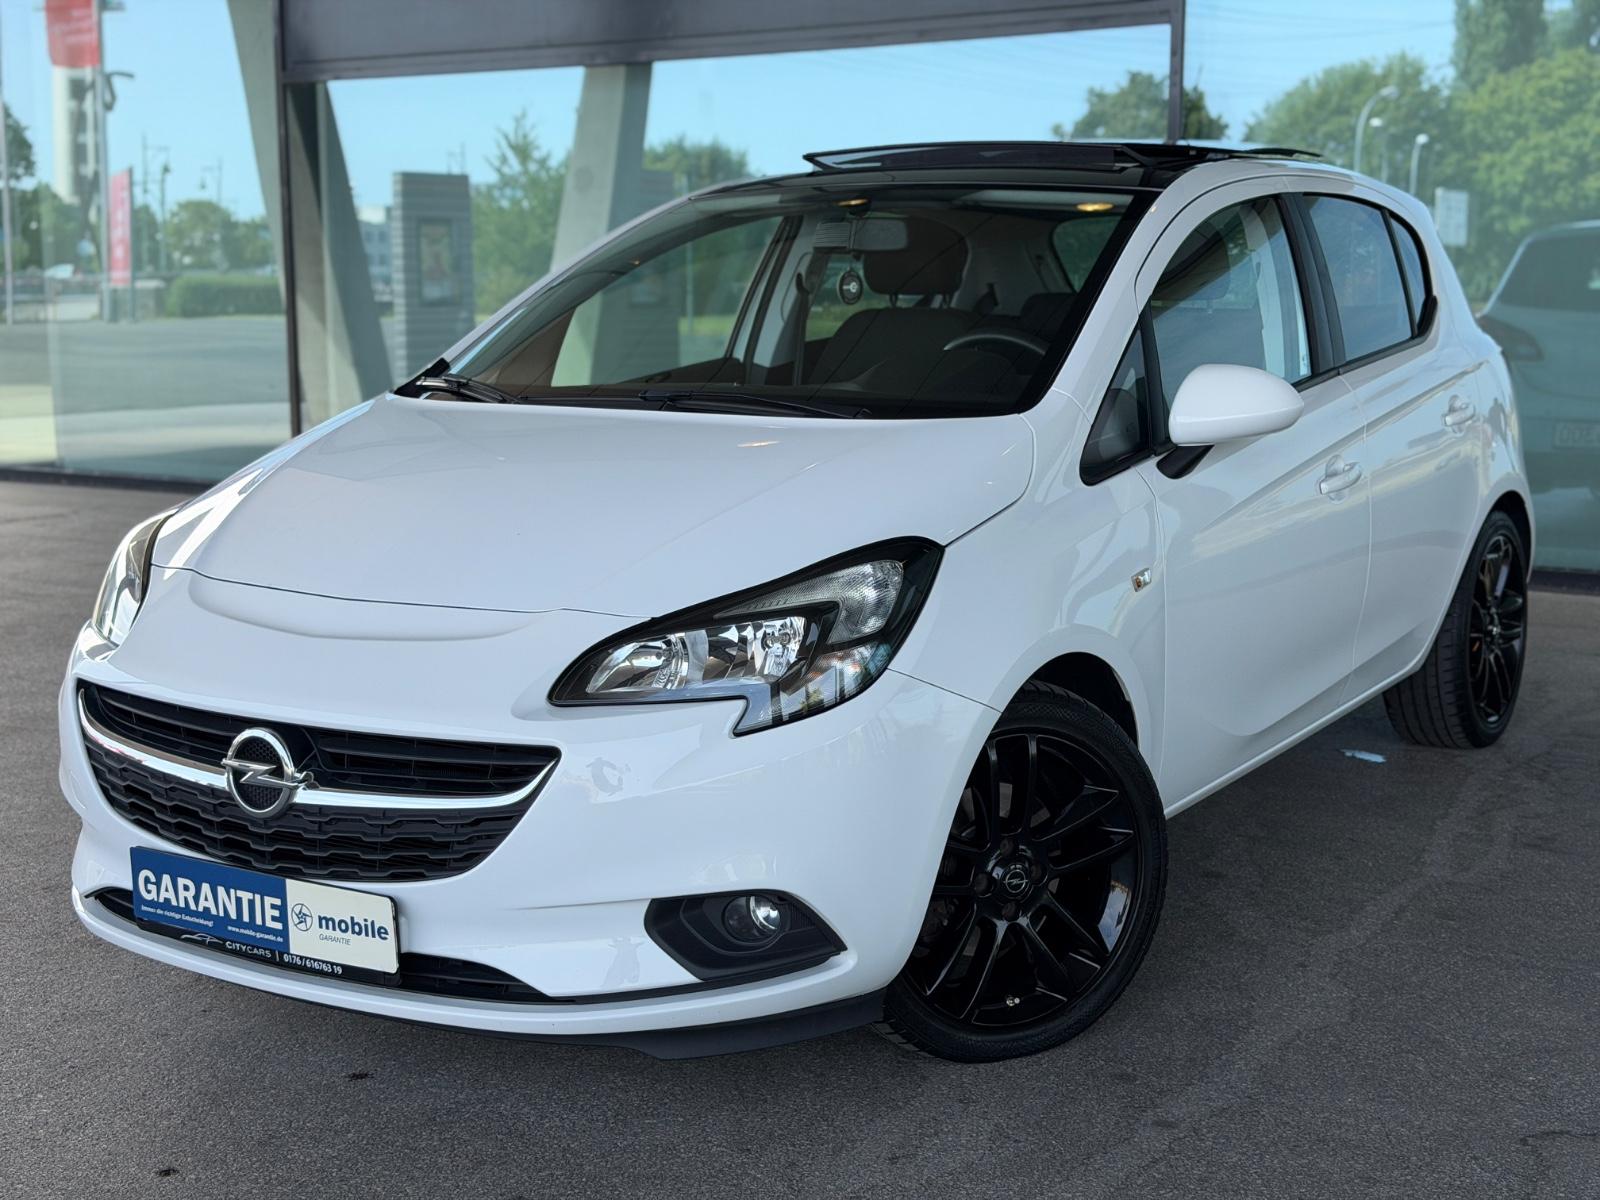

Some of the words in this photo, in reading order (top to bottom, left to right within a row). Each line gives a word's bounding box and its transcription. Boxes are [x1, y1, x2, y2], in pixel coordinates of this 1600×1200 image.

[138, 869, 283, 930] GARANTIE
[227, 926, 284, 942] www.mobile-garantie.de
[318, 914, 389, 940] mobile
[319, 933, 351, 945] GARANTIE
[225, 941, 272, 958] CITYCARS
[333, 965, 342, 974] 19
